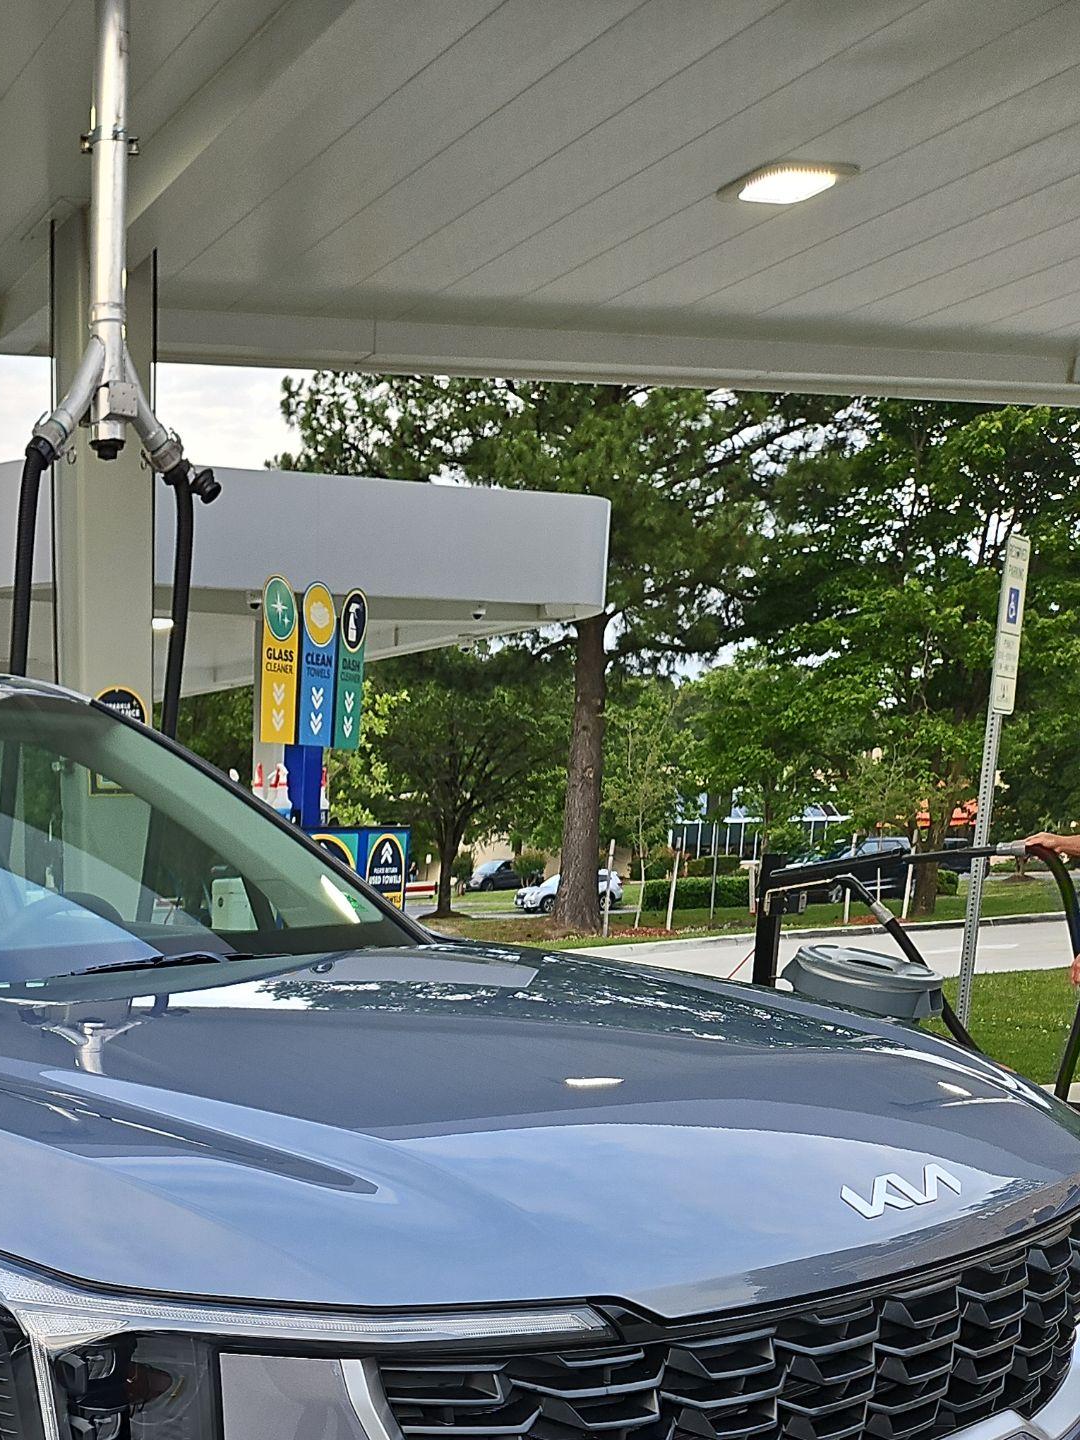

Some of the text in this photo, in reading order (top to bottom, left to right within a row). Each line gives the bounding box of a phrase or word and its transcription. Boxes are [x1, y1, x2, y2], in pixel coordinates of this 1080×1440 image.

[266, 647, 294, 663] GLASS
[305, 653, 333, 668] CLEAN
[265, 662, 293, 675] CLEANER
[306, 667, 331, 679] TOWELS
